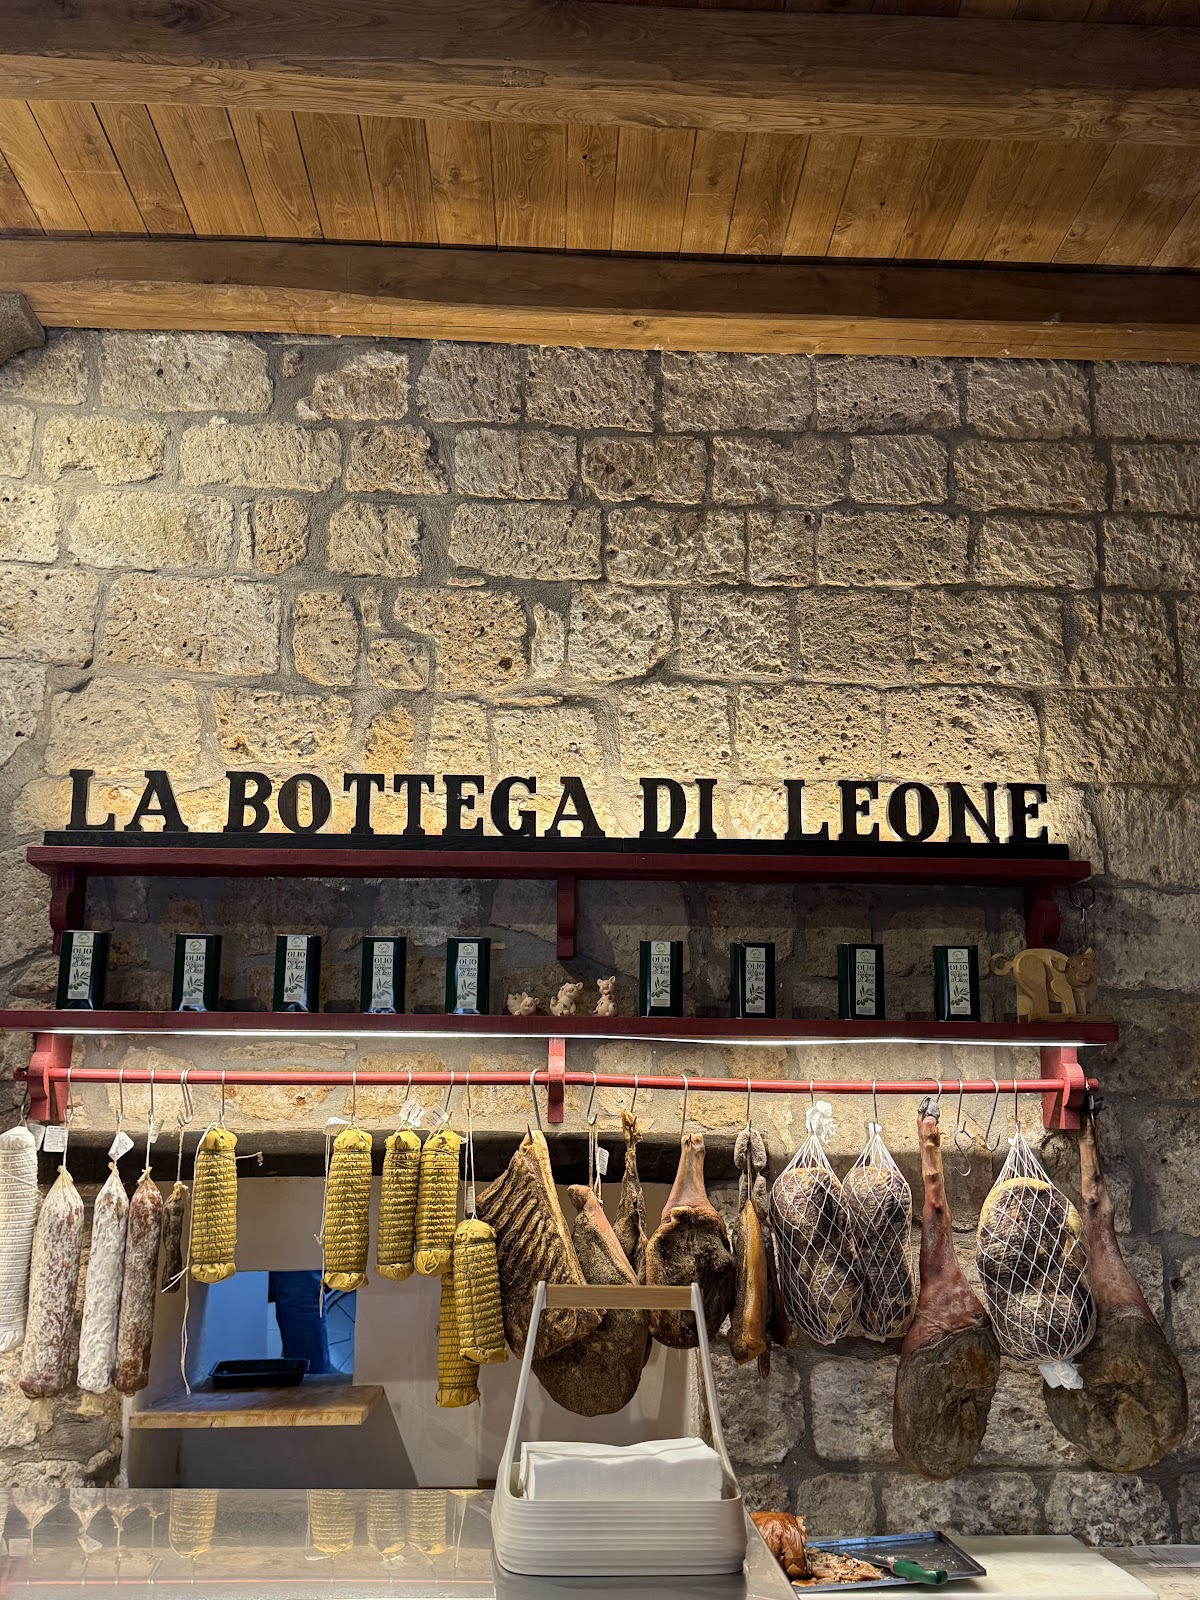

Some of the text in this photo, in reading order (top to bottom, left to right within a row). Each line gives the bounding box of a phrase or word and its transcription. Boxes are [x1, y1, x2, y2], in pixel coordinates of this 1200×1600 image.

[65, 768, 1049, 845] LA BOTTEGA DI LEONE
